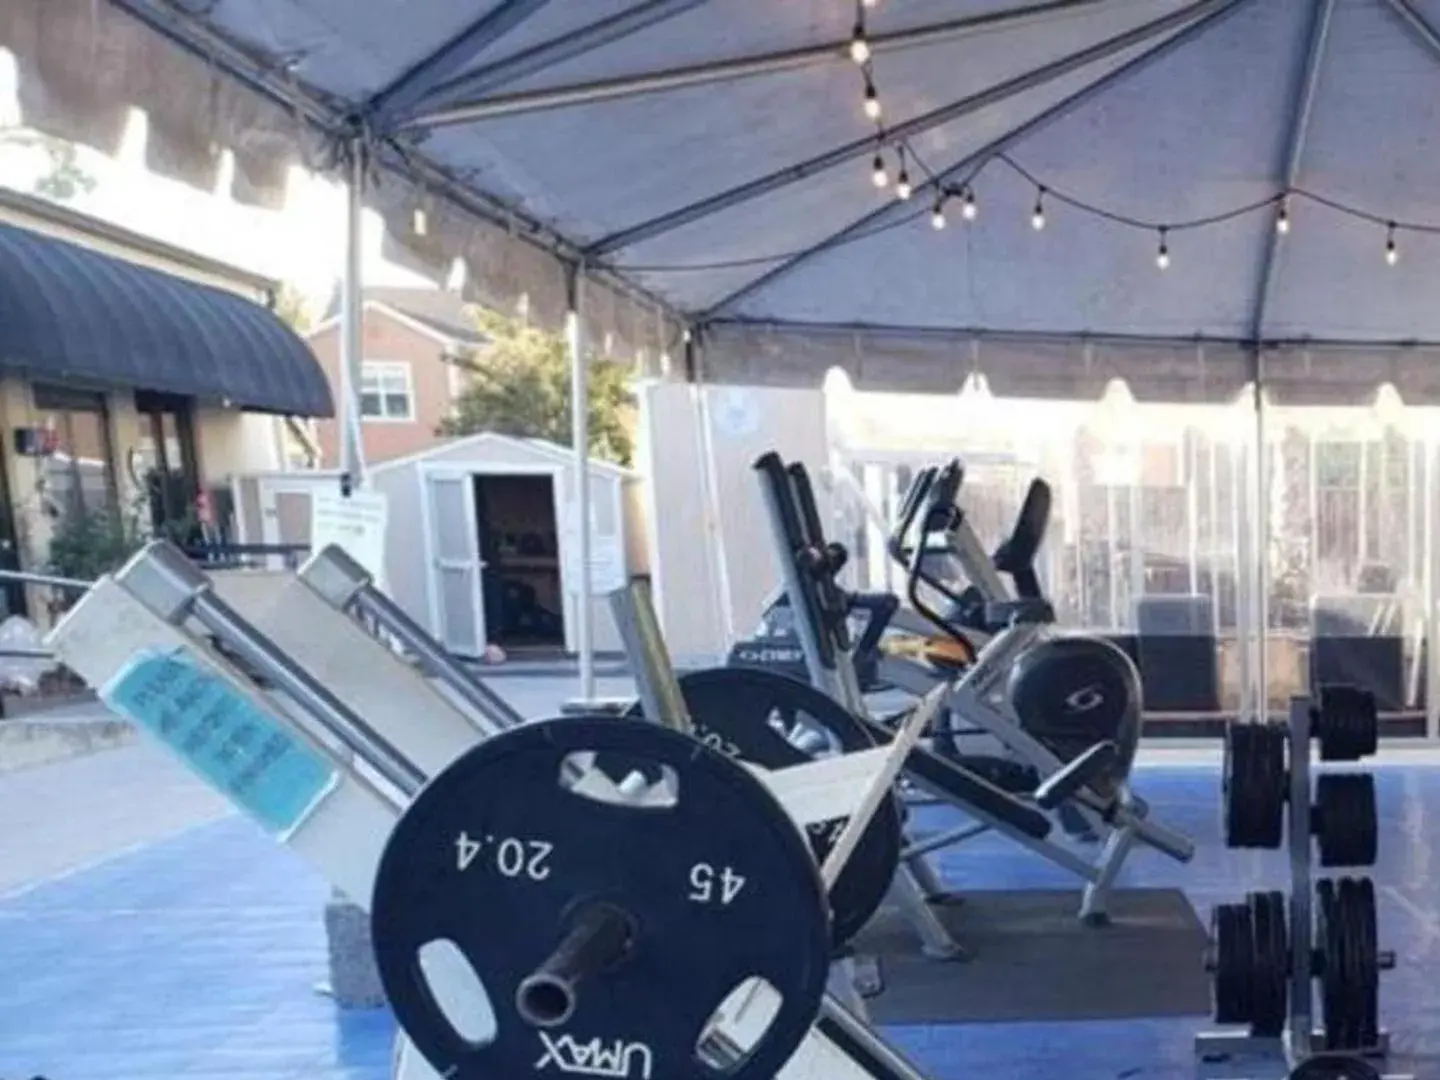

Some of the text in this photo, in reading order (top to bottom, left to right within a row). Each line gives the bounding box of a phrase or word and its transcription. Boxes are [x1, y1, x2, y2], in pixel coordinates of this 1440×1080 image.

[455, 831, 553, 881] 20.4
[689, 863, 746, 904] 45
[535, 1031, 652, 1080] UMAX
